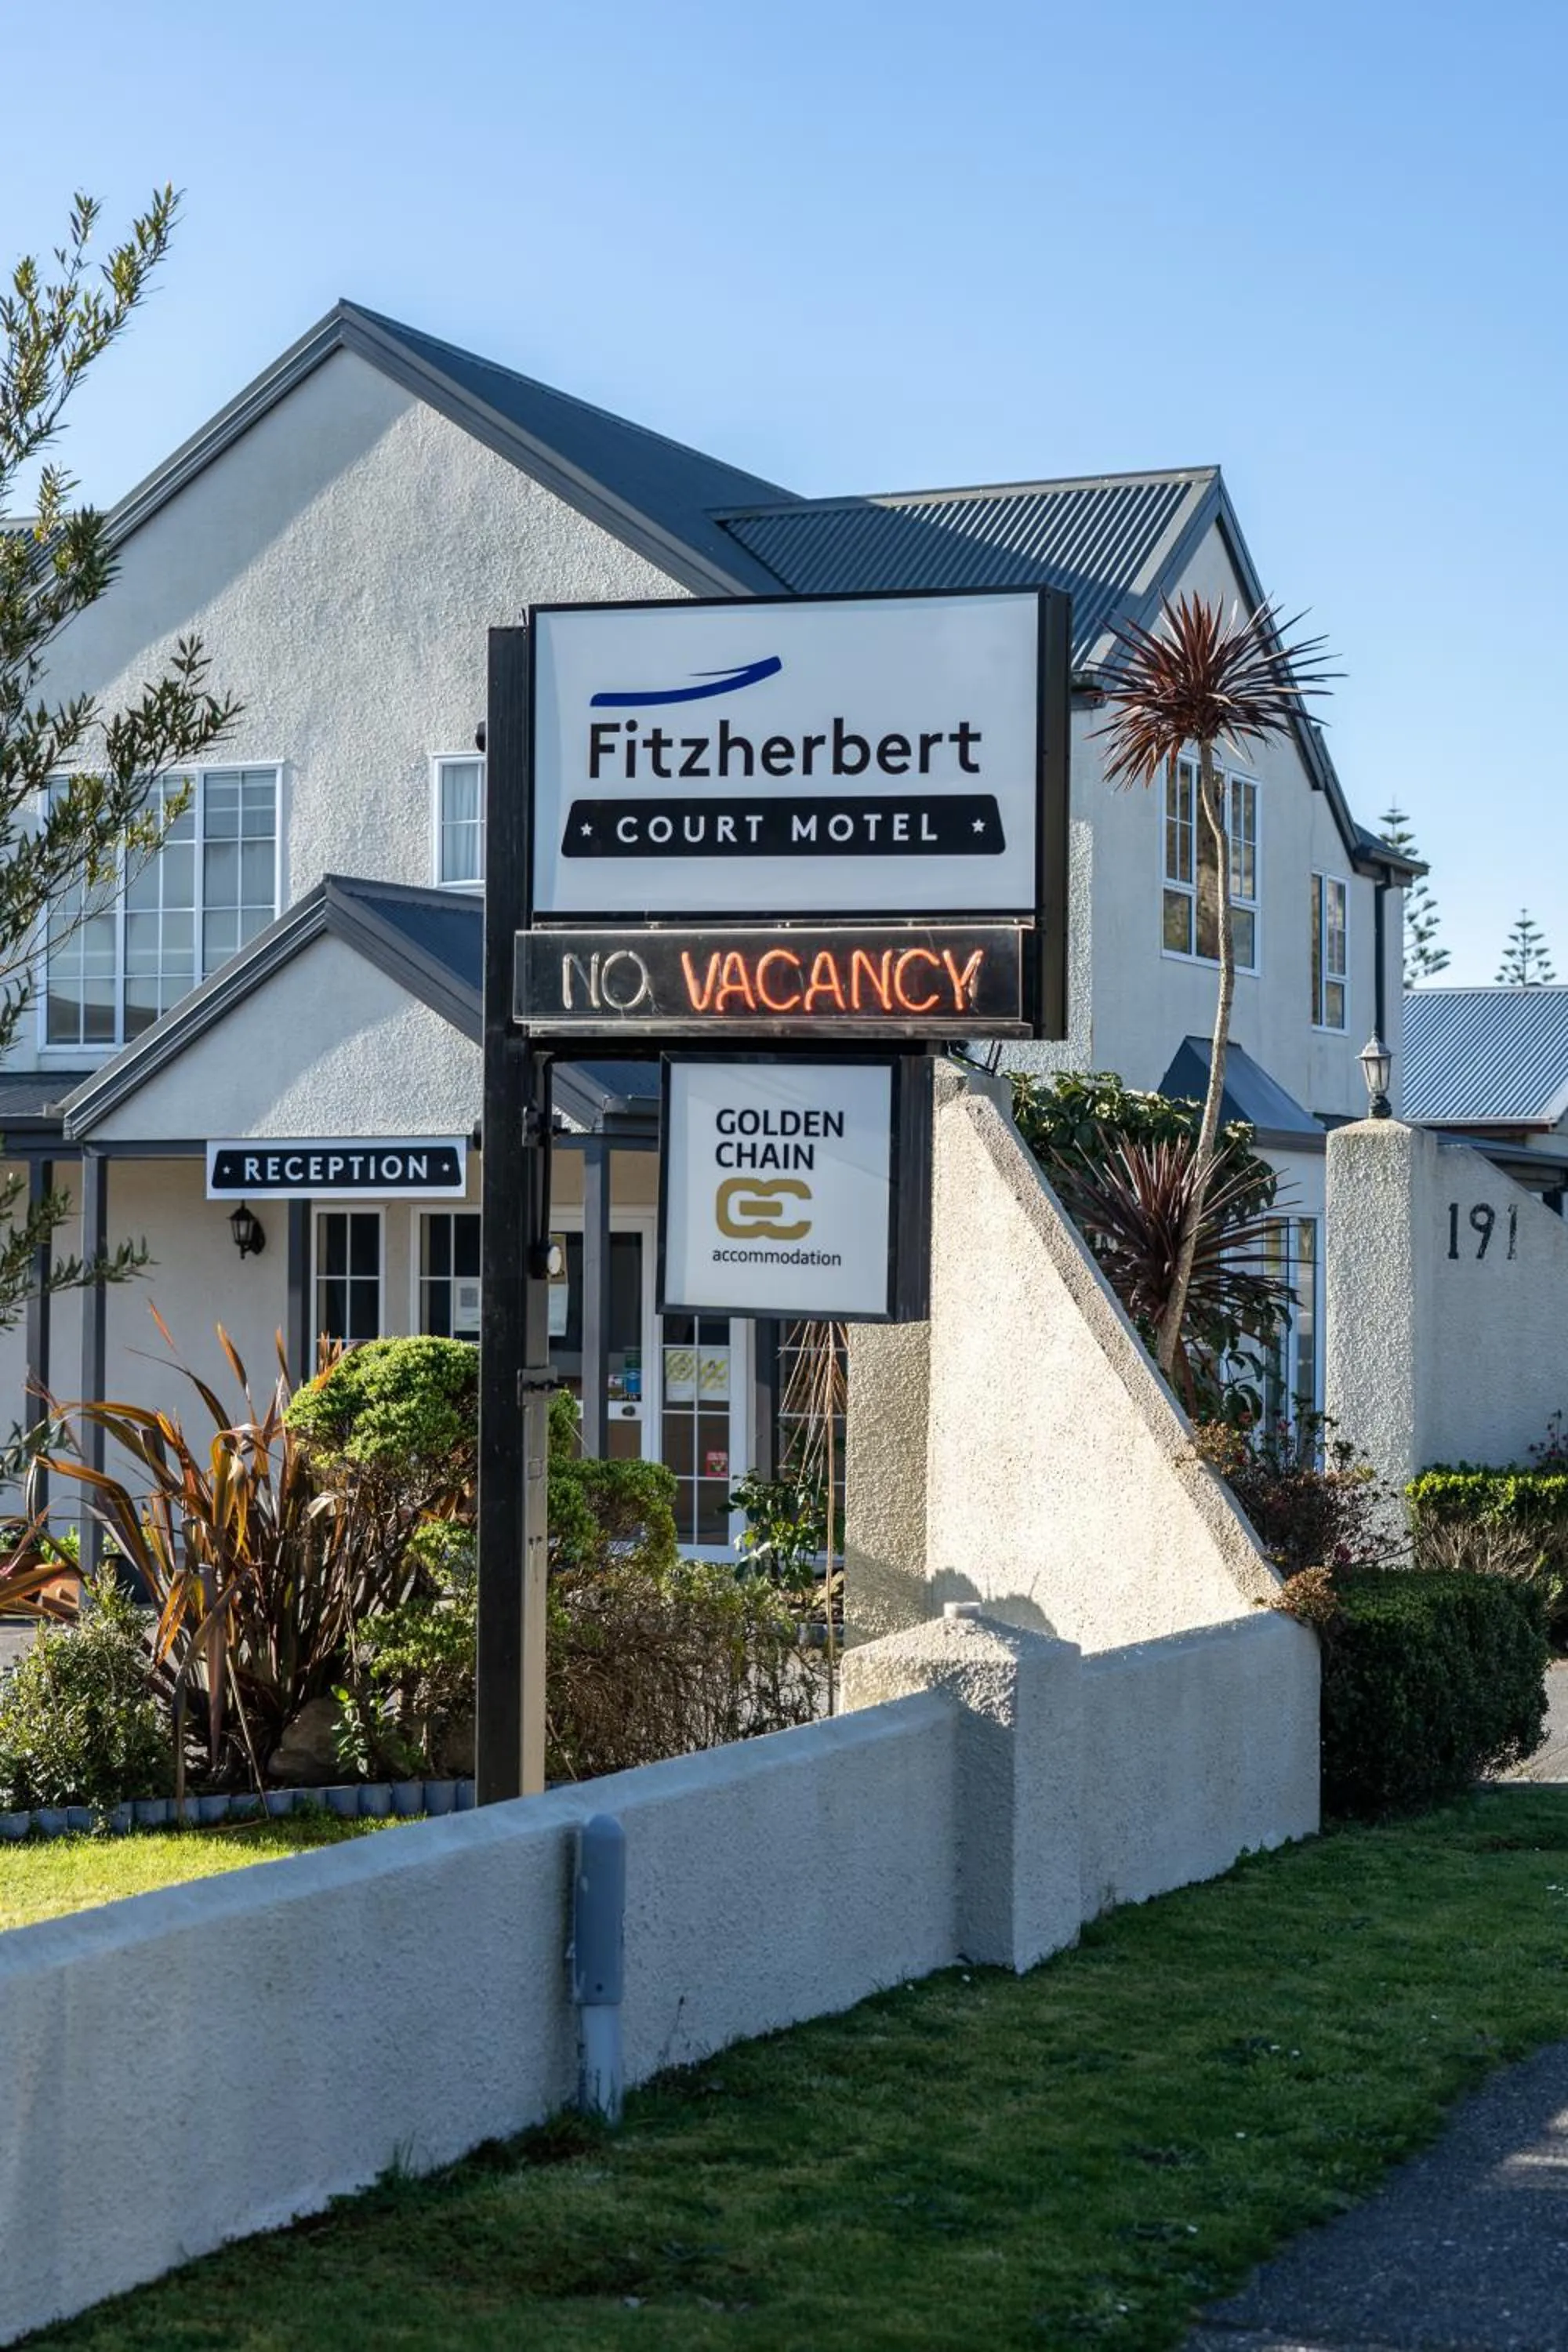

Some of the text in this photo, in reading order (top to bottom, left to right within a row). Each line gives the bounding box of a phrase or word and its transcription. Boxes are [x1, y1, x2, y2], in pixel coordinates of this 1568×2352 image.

[590, 717, 982, 778] Fitzherbert
[617, 813, 938, 843] COURT MOTEL
[562, 949, 984, 1011] NO VACANCY
[716, 1109, 844, 1138] GOLDEN
[244, 1155, 428, 1181] RECEPTION
[716, 1142, 815, 1171] CHAIN
[1448, 1203, 1518, 1260] 191
[712, 1247, 842, 1267] accommodation
